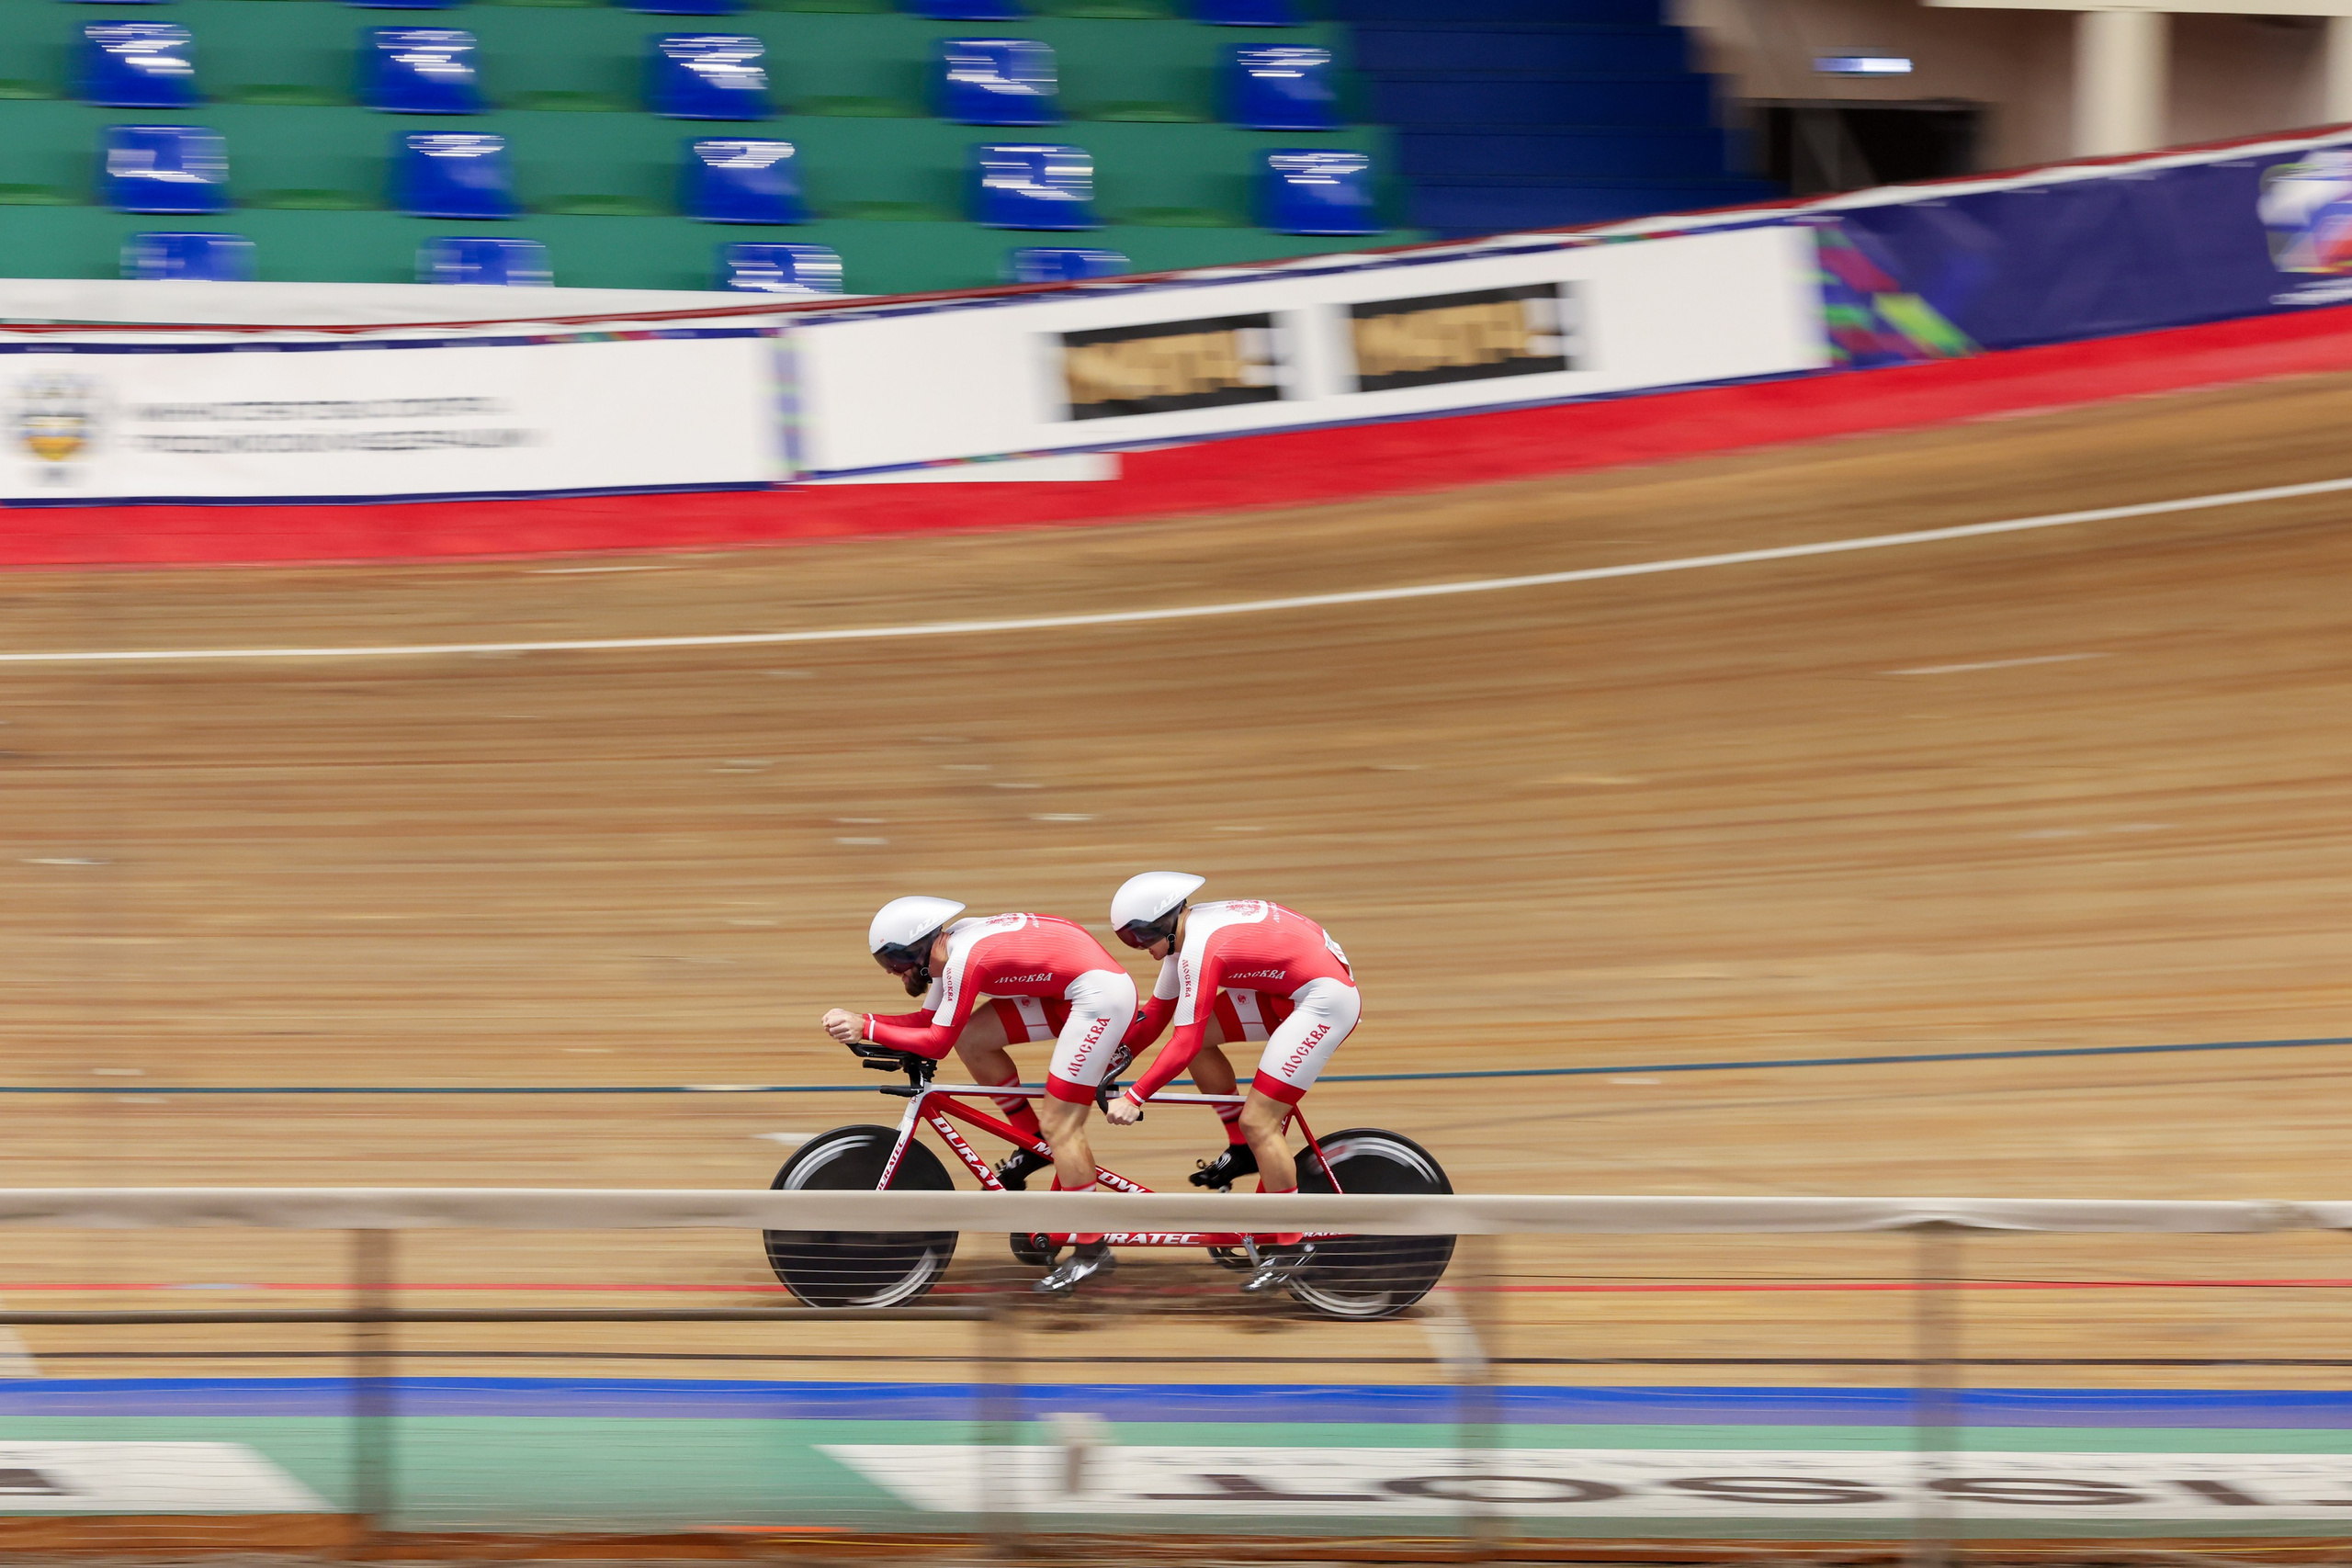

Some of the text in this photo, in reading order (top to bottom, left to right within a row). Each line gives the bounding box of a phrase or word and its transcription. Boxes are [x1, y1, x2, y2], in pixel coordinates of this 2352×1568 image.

[994, 972, 1054, 984] МОСКВА
[1228, 969, 1286, 980] МОСКВА
[1068, 1018, 1111, 1077] МОСКВА
[1281, 1023, 1331, 1077] МОСКВА
[932, 1117, 1007, 1191] DURAT
